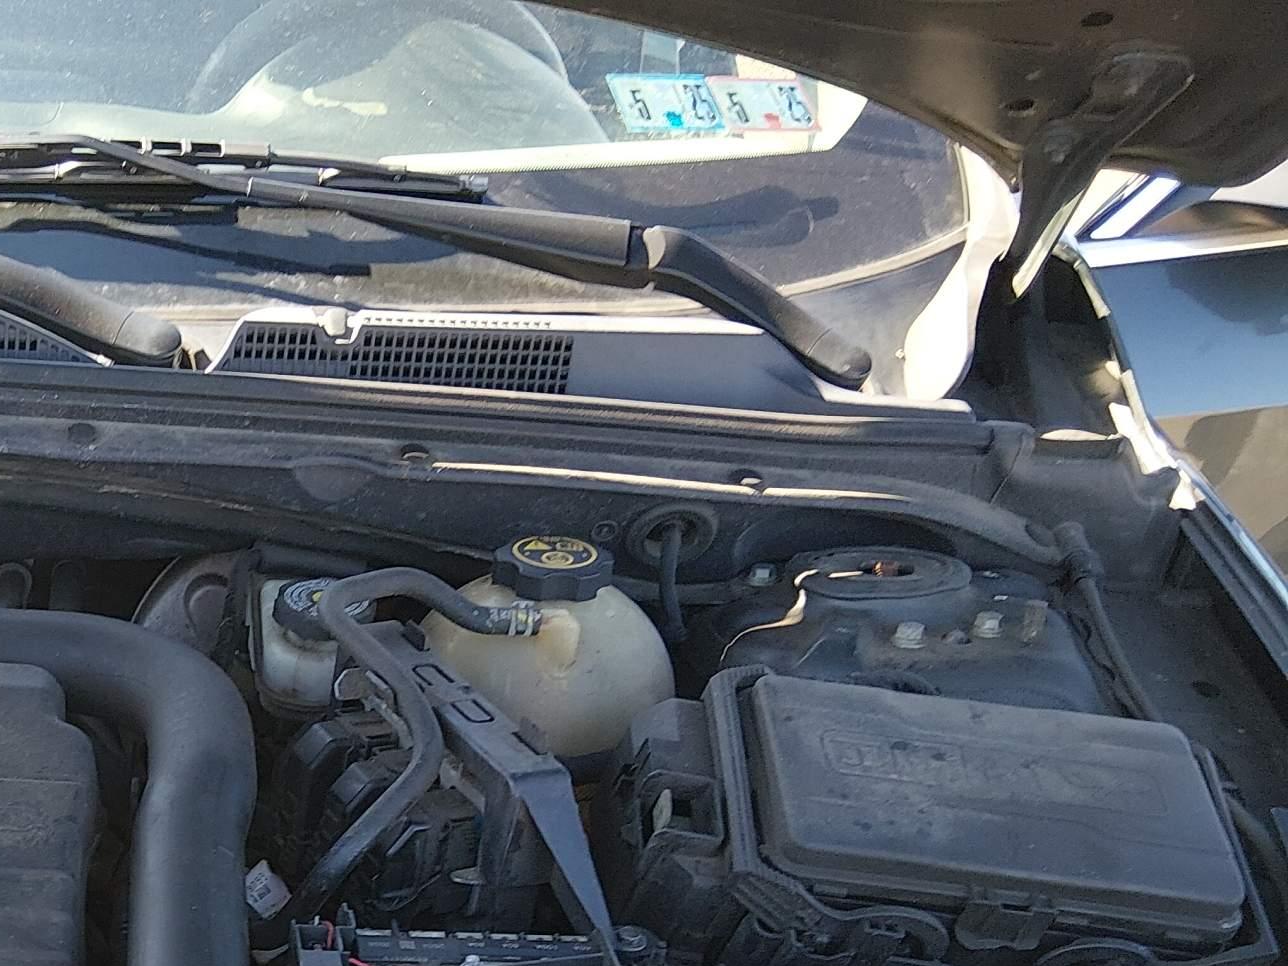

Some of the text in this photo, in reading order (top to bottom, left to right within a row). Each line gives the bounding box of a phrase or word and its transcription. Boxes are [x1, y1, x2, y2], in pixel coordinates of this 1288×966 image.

[628, 83, 717, 121] 5 25
[726, 85, 815, 124] 5 25
